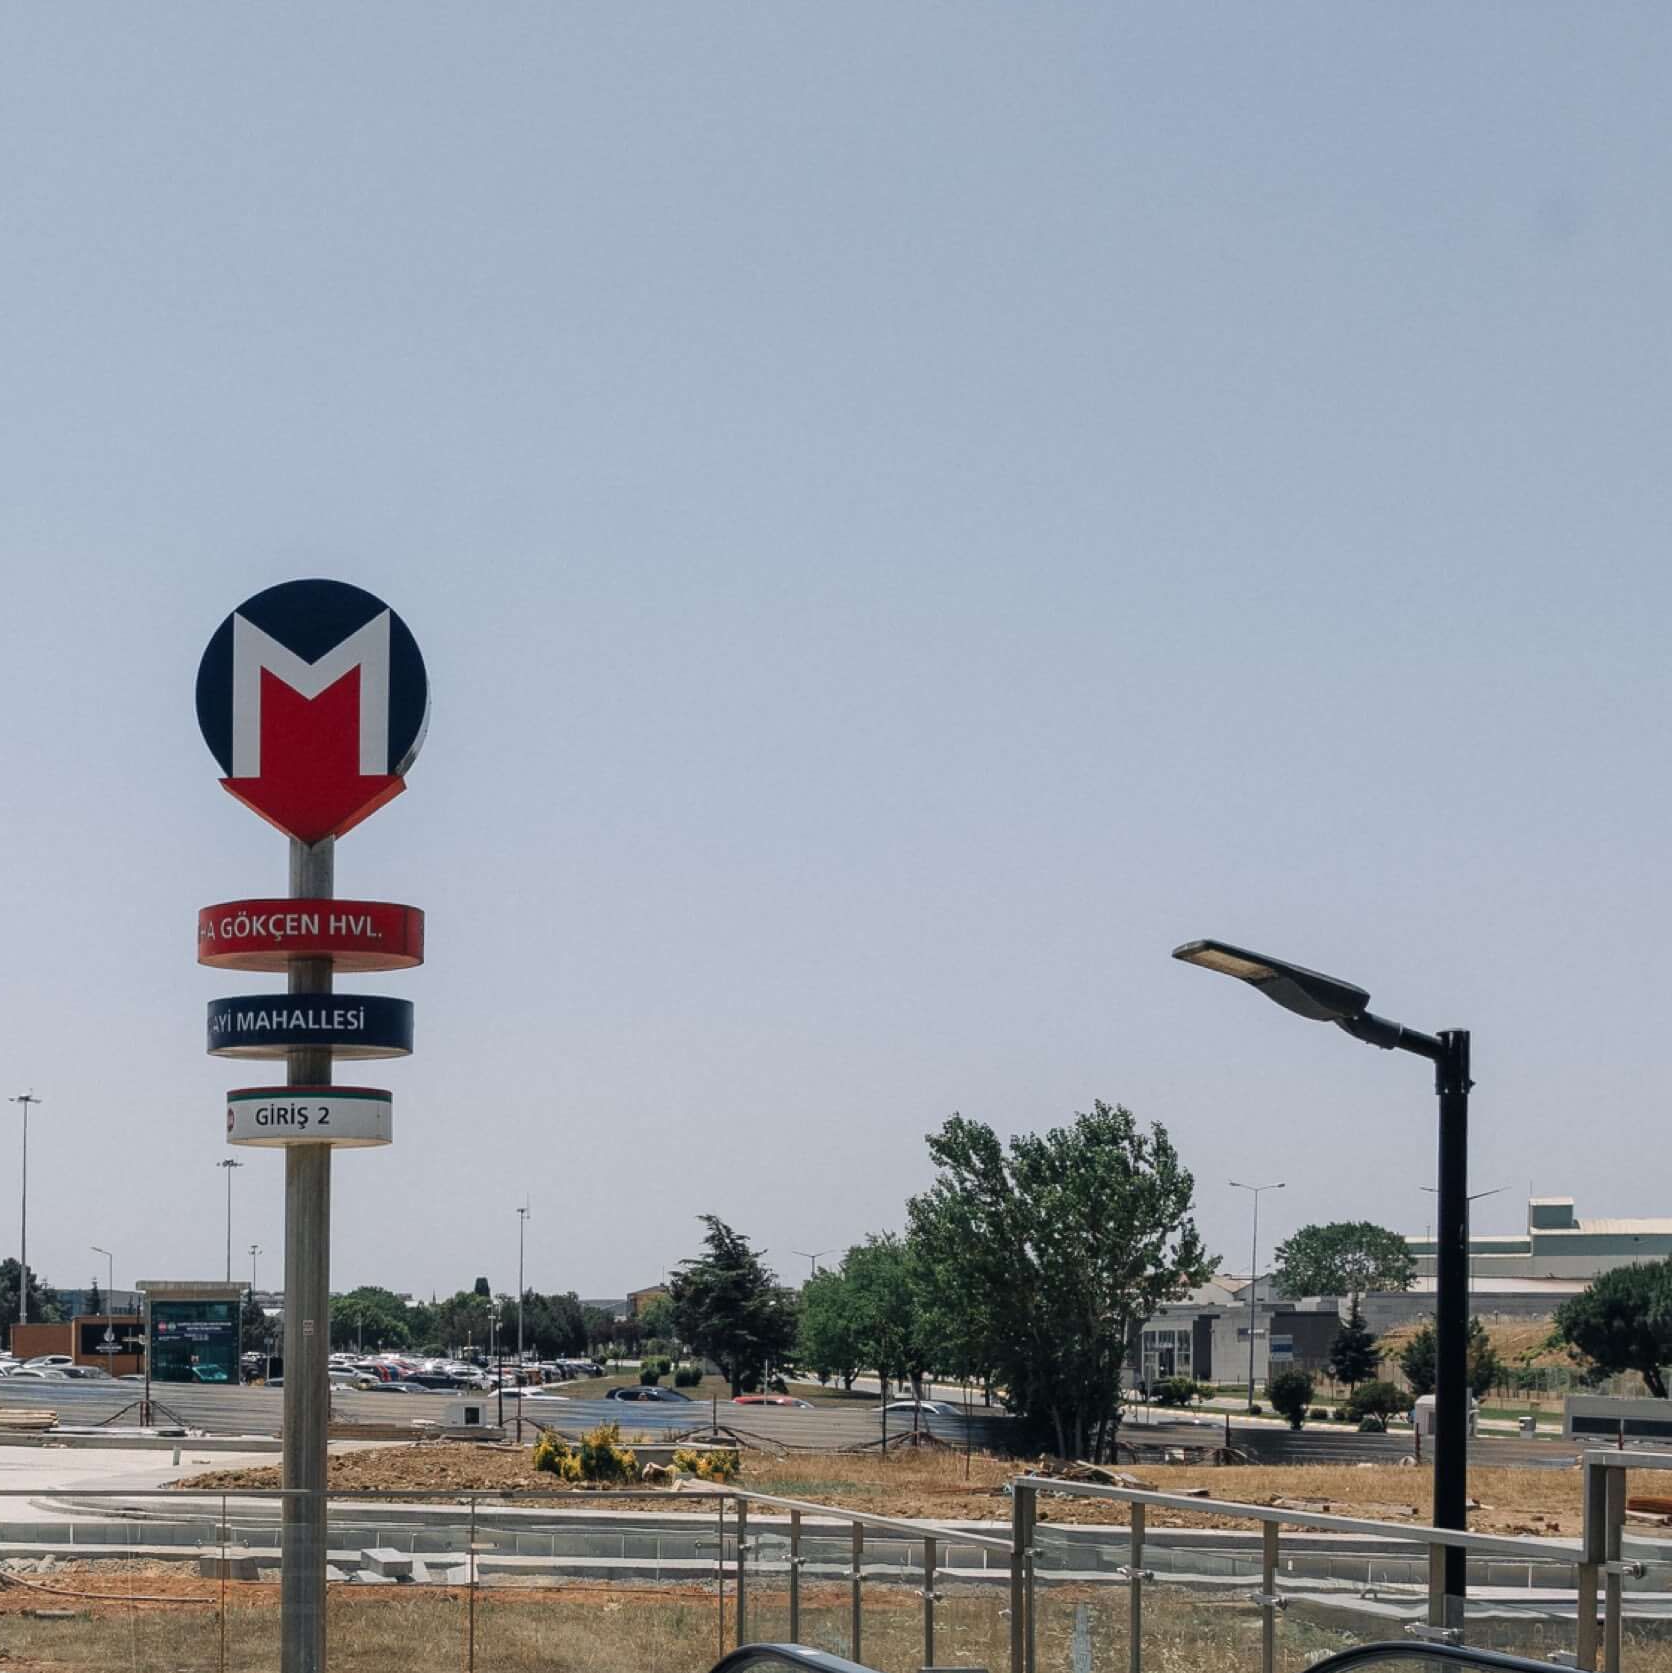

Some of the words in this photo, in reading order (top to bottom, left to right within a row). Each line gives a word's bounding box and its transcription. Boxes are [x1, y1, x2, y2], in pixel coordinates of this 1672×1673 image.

[220, 911, 319, 941] GÖKÇEN
[329, 914, 382, 938] HVL.
[236, 1006, 365, 1032] MAHALLESİ
[255, 1103, 309, 1129] GİRİŞ
[317, 1106, 331, 1126] 2
